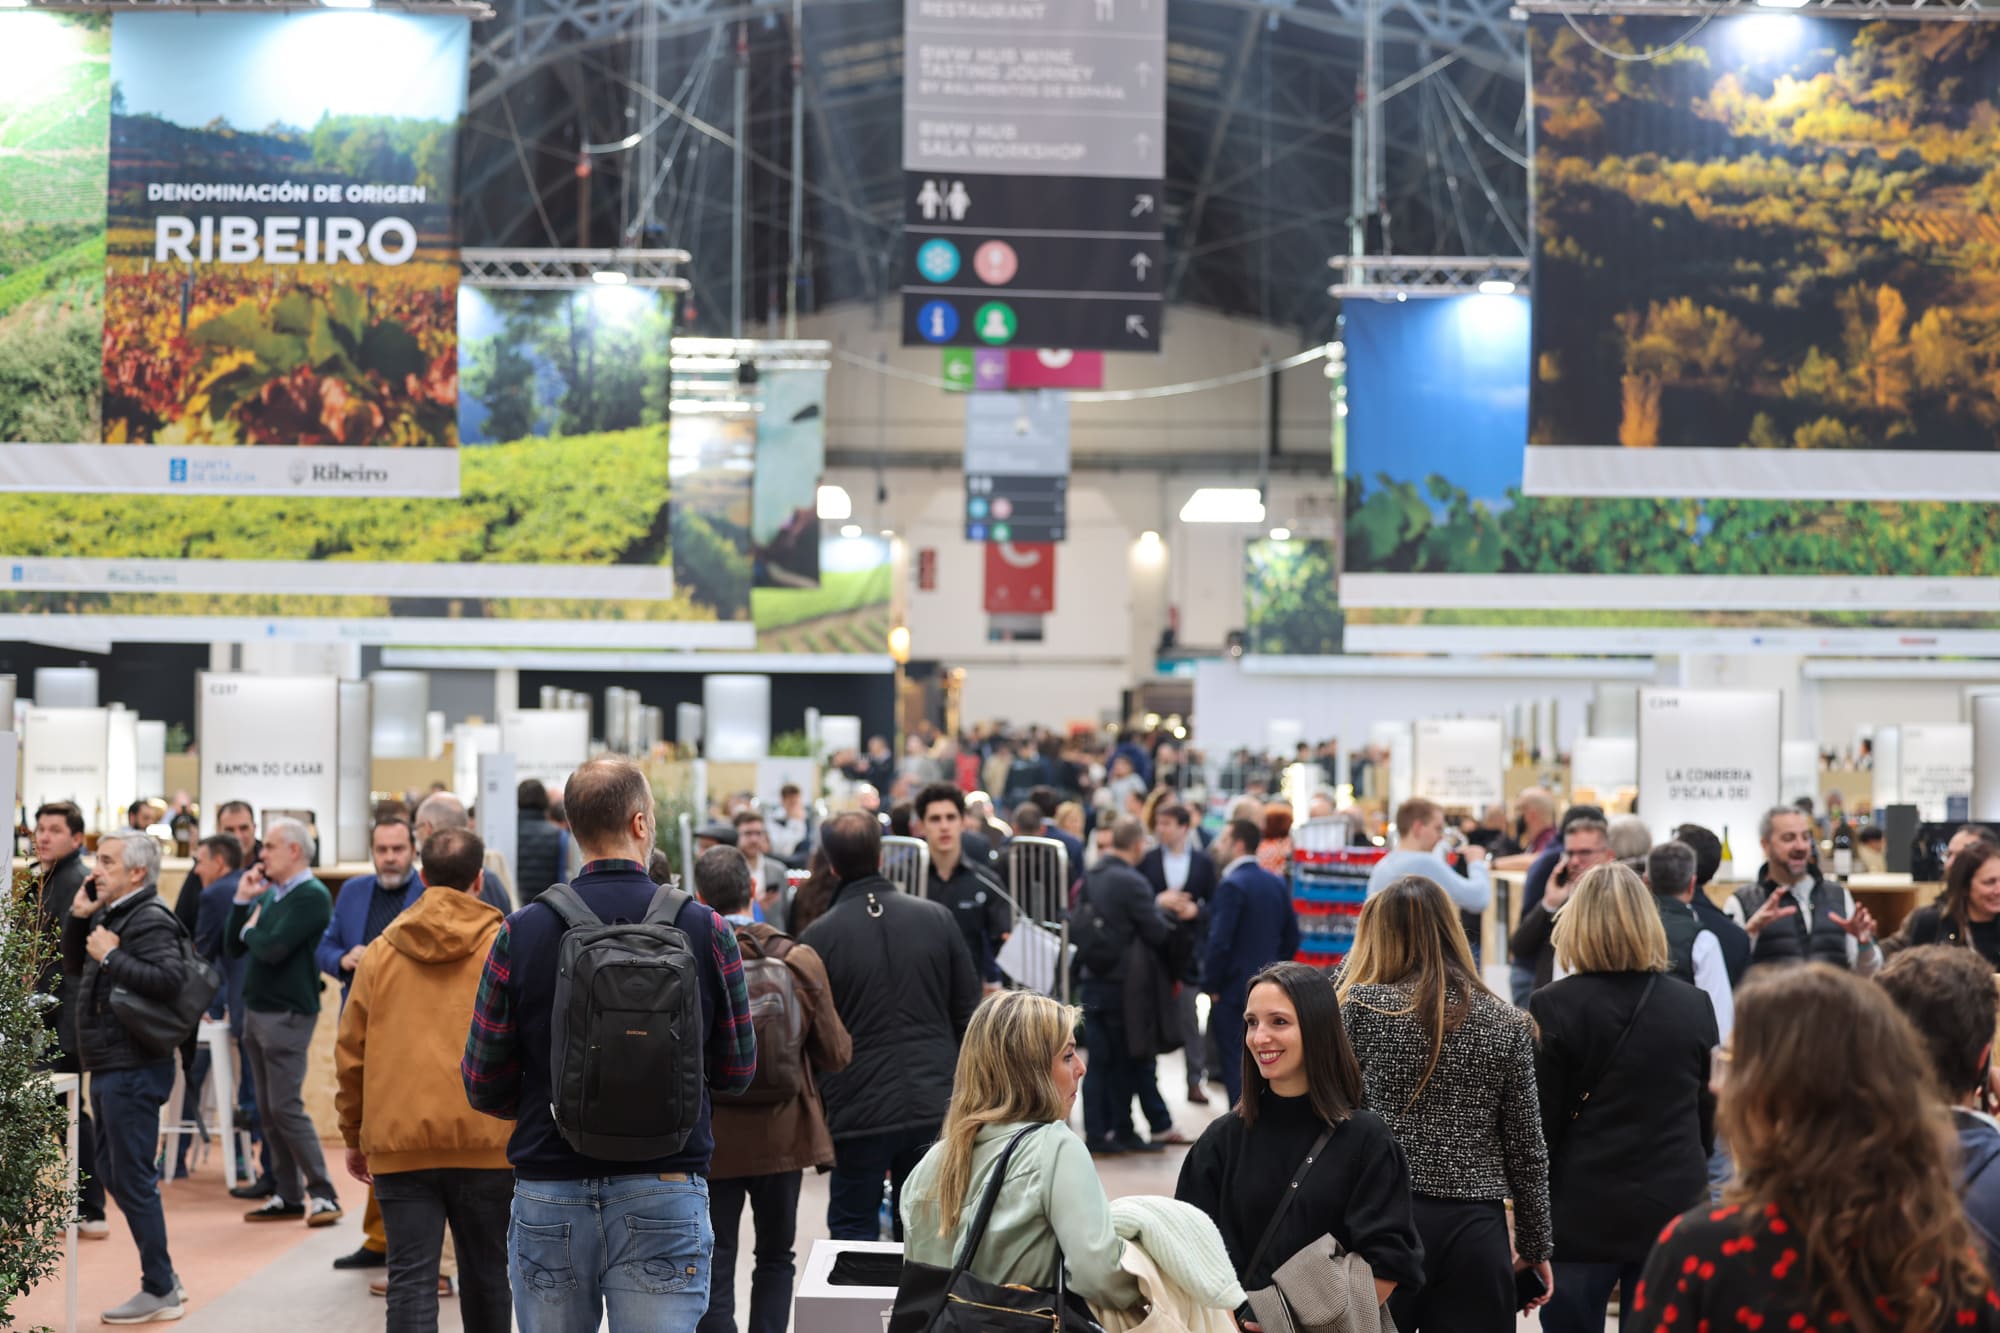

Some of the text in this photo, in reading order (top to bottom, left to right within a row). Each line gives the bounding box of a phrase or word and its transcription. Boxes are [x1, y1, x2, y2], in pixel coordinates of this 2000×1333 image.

[919, 1, 1047, 19] RESTAURANT
[920, 46, 1073, 65] BWW HUB WINE
[920, 64, 1095, 82] TASTING JOURNEY
[918, 121, 1017, 140] BWW HUB
[919, 140, 1088, 160] SALA WORKSHOP
[148, 180, 427, 203] DENOMINACIÓN DE ORIGEN
[154, 214, 418, 266] RIBEIRO
[312, 462, 388, 482] Ribeiro
[262, 761, 280, 776] DO
[283, 761, 323, 776] CASAR
[1665, 767, 1682, 782] LA
